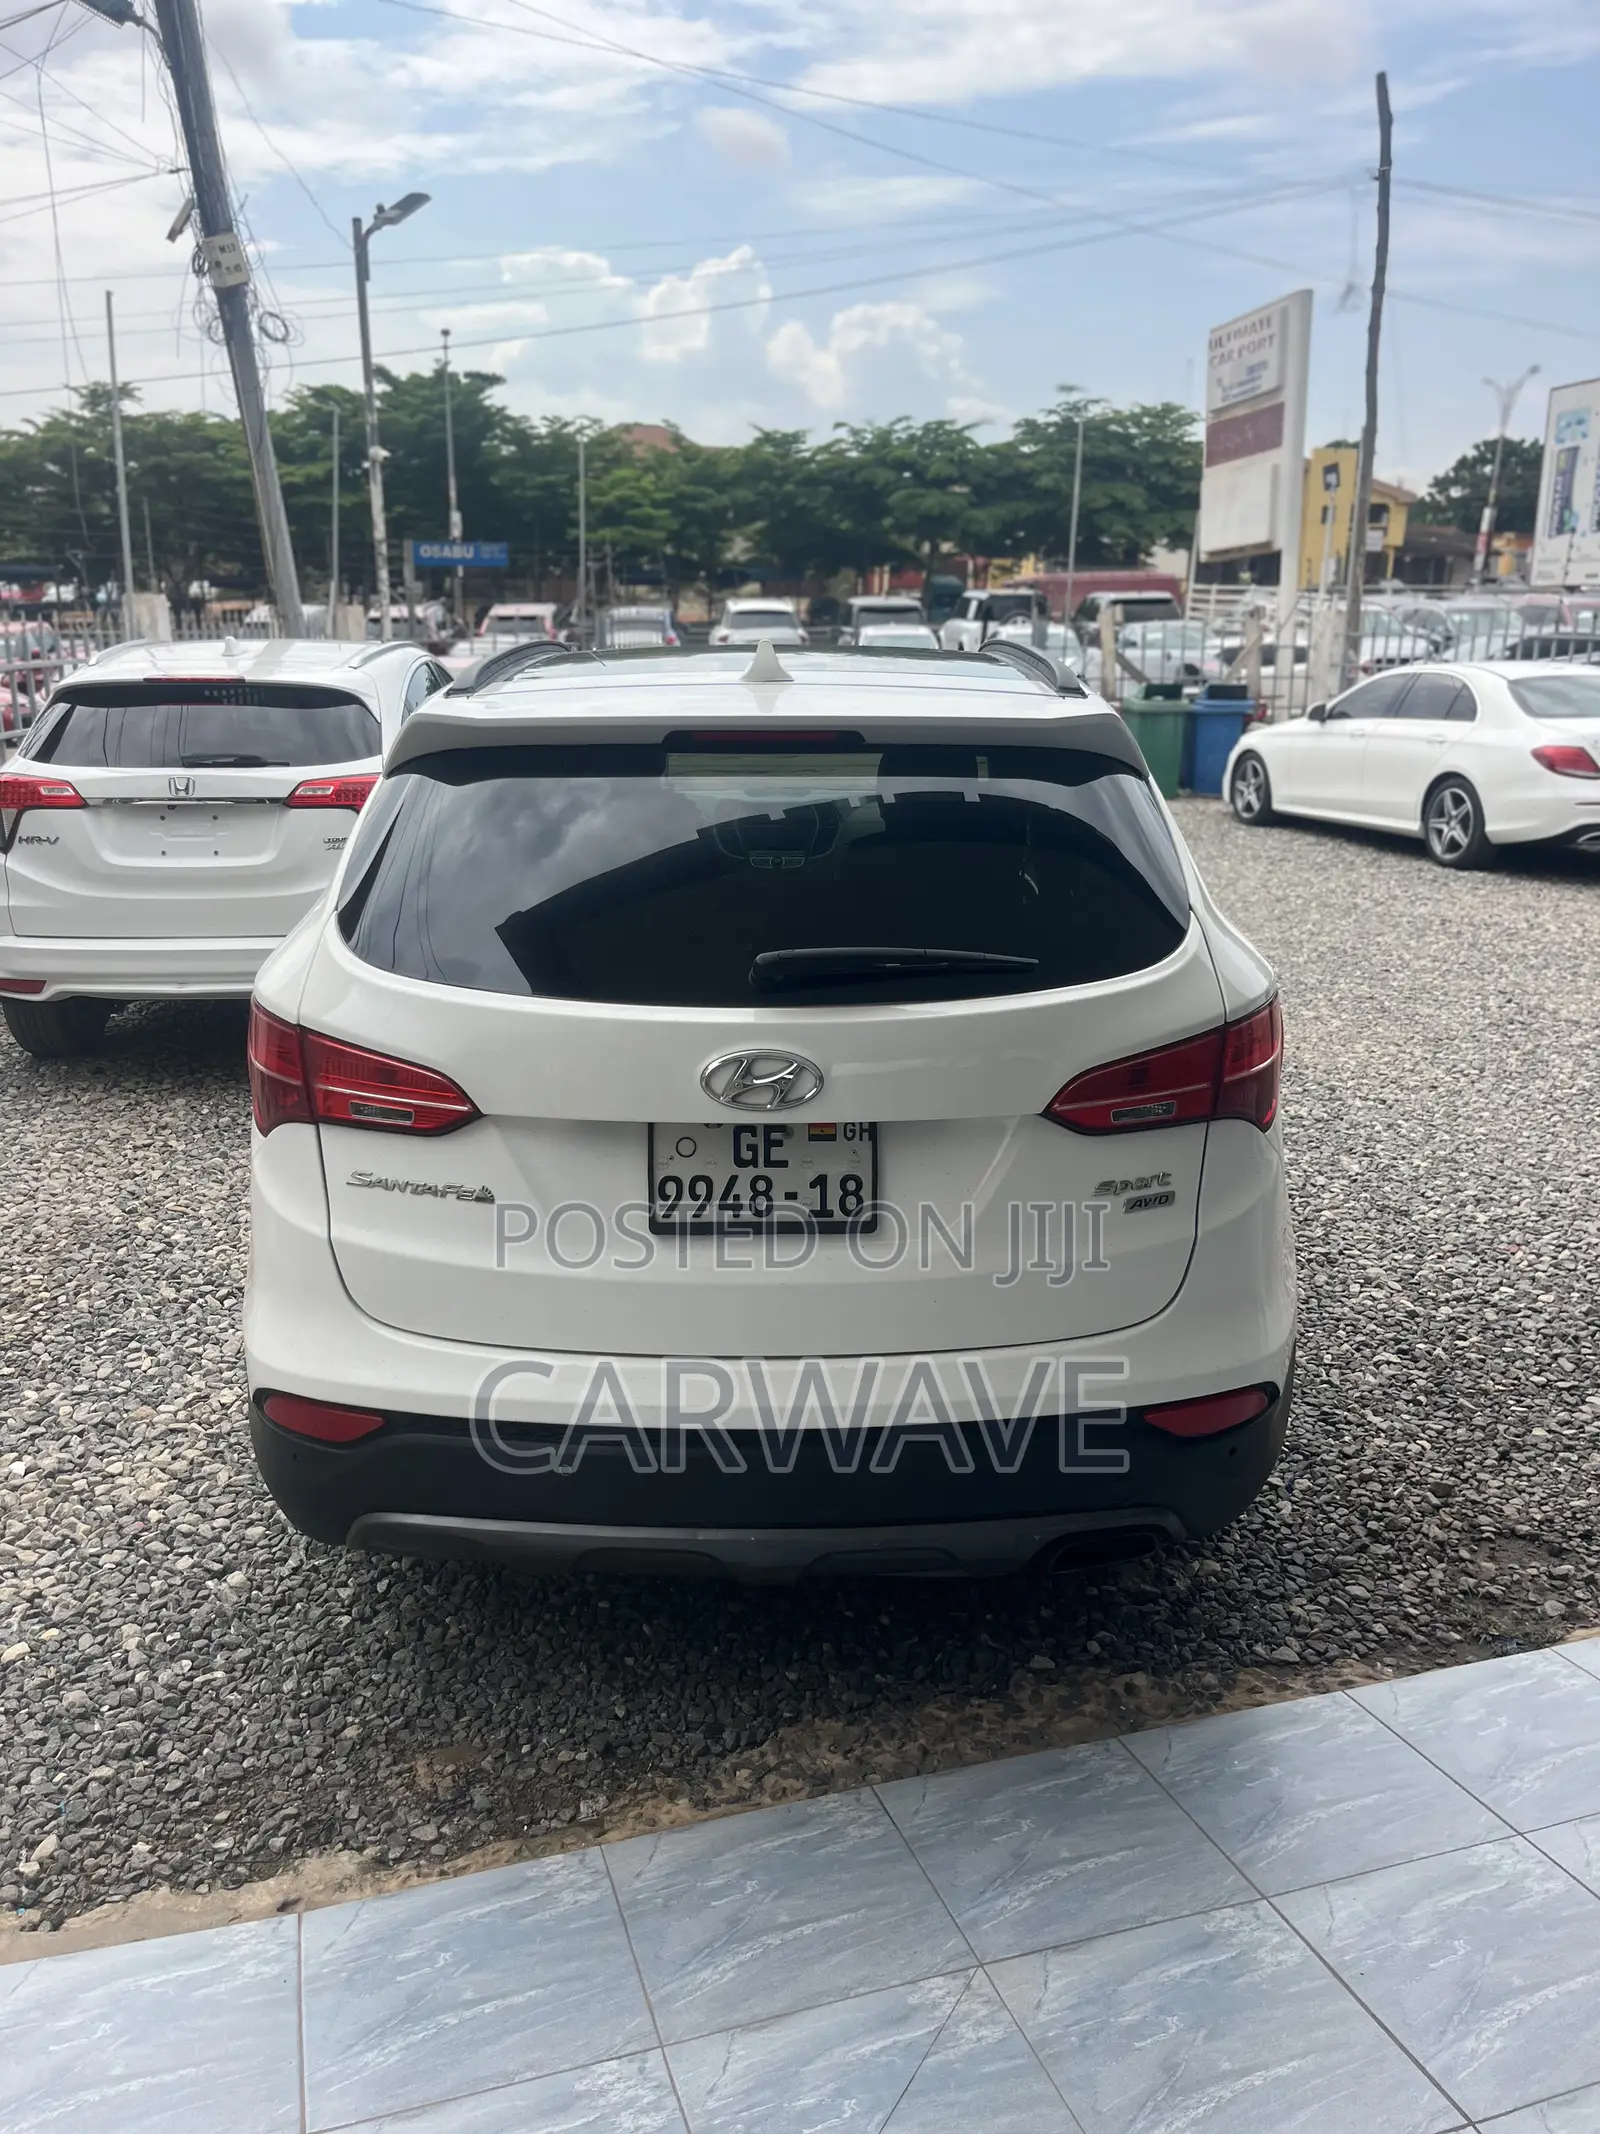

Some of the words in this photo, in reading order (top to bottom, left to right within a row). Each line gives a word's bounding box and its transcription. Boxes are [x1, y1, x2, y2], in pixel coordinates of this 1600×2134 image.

[1209, 348, 1235, 369] CAR
[1237, 332, 1276, 359] PORT
[18, 835, 60, 845] HR-V
[843, 1122, 873, 1142] GH
[733, 1125, 789, 1169] GE
[1129, 1194, 1170, 1210] AWD
